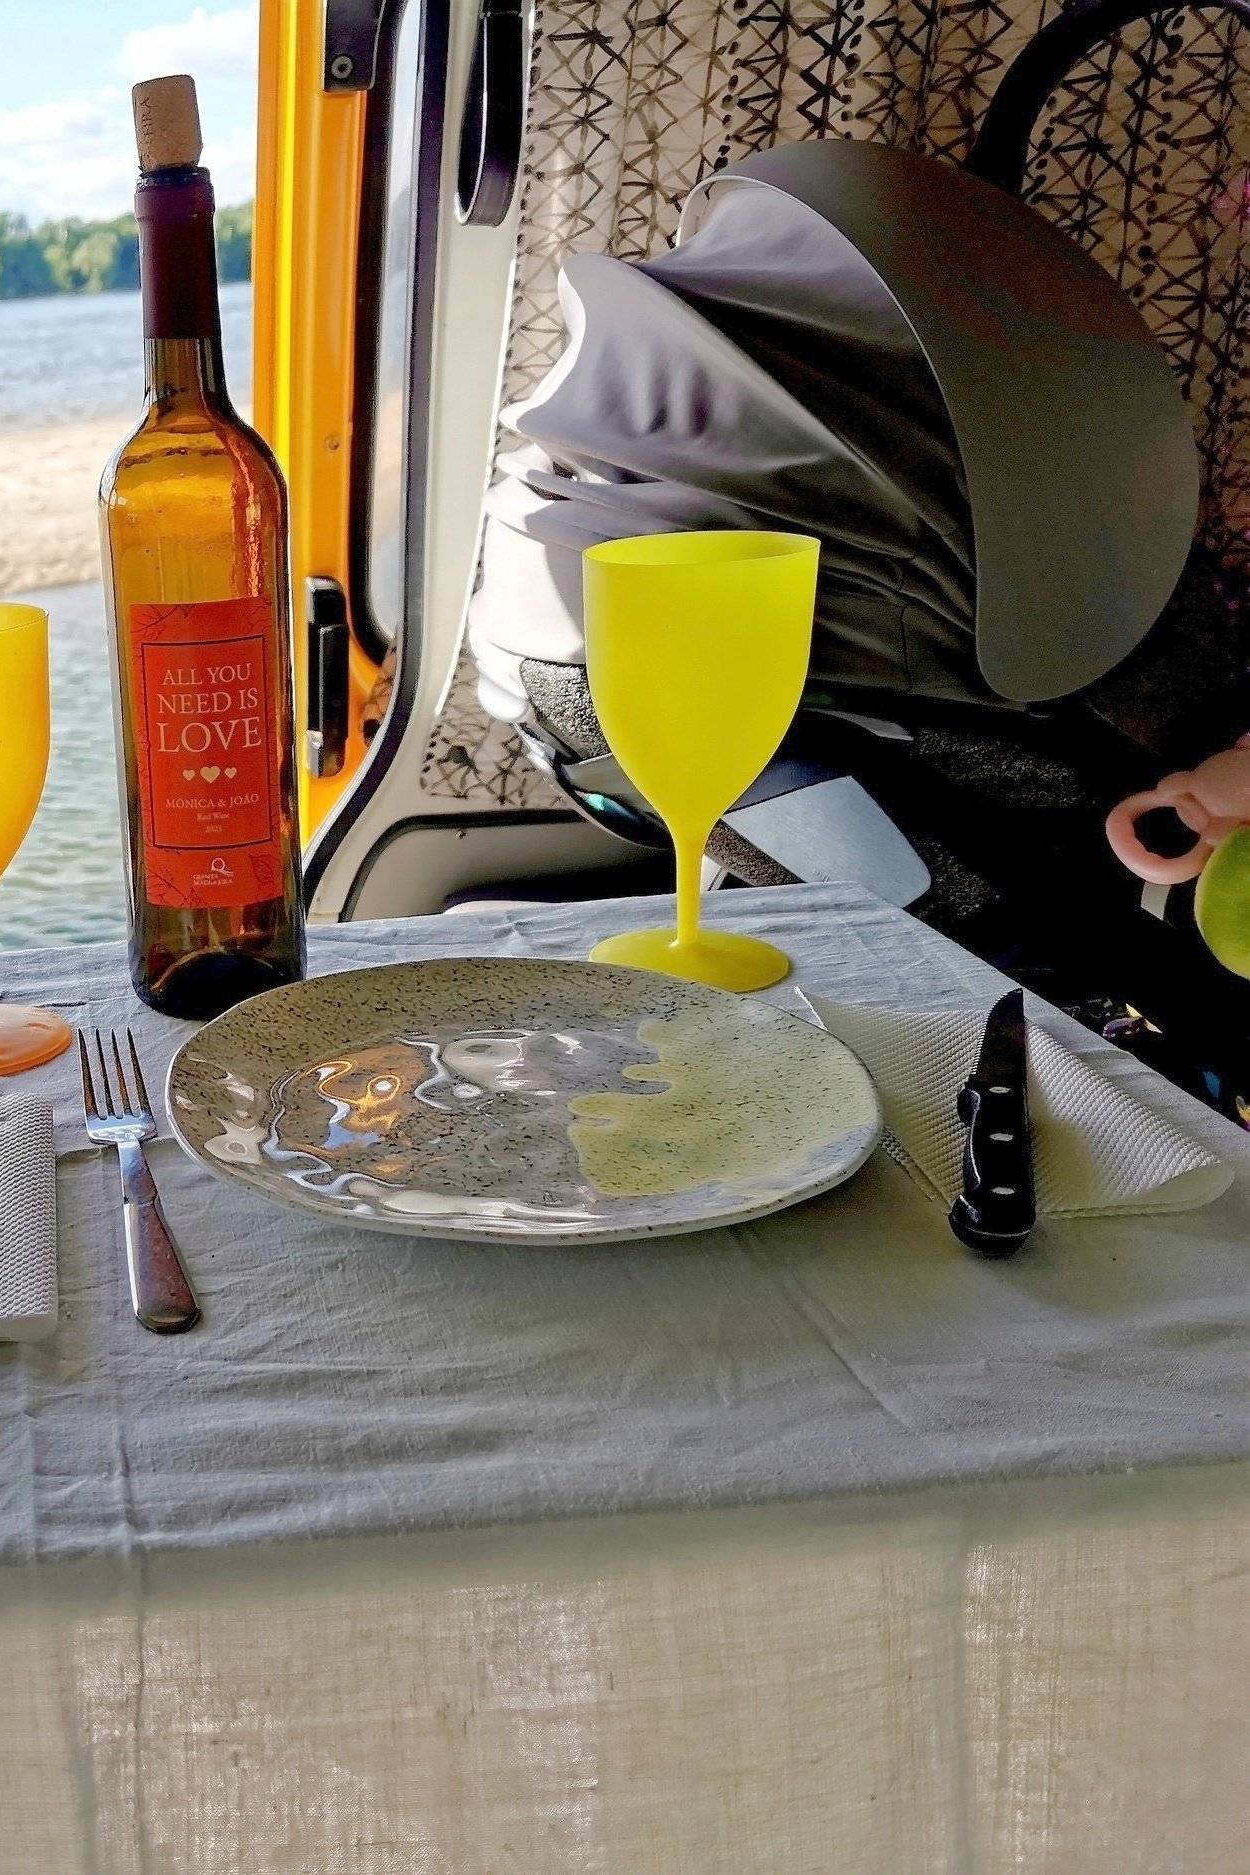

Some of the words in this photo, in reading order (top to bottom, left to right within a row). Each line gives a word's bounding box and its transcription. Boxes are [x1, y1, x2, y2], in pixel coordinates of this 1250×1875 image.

[161, 669, 202, 685] ALL
[206, 663, 251, 684] YOU
[157, 692, 232, 713] NEED
[238, 688, 258, 710] IS
[156, 716, 262, 752] LOVE
[217, 799, 225, 807] &
